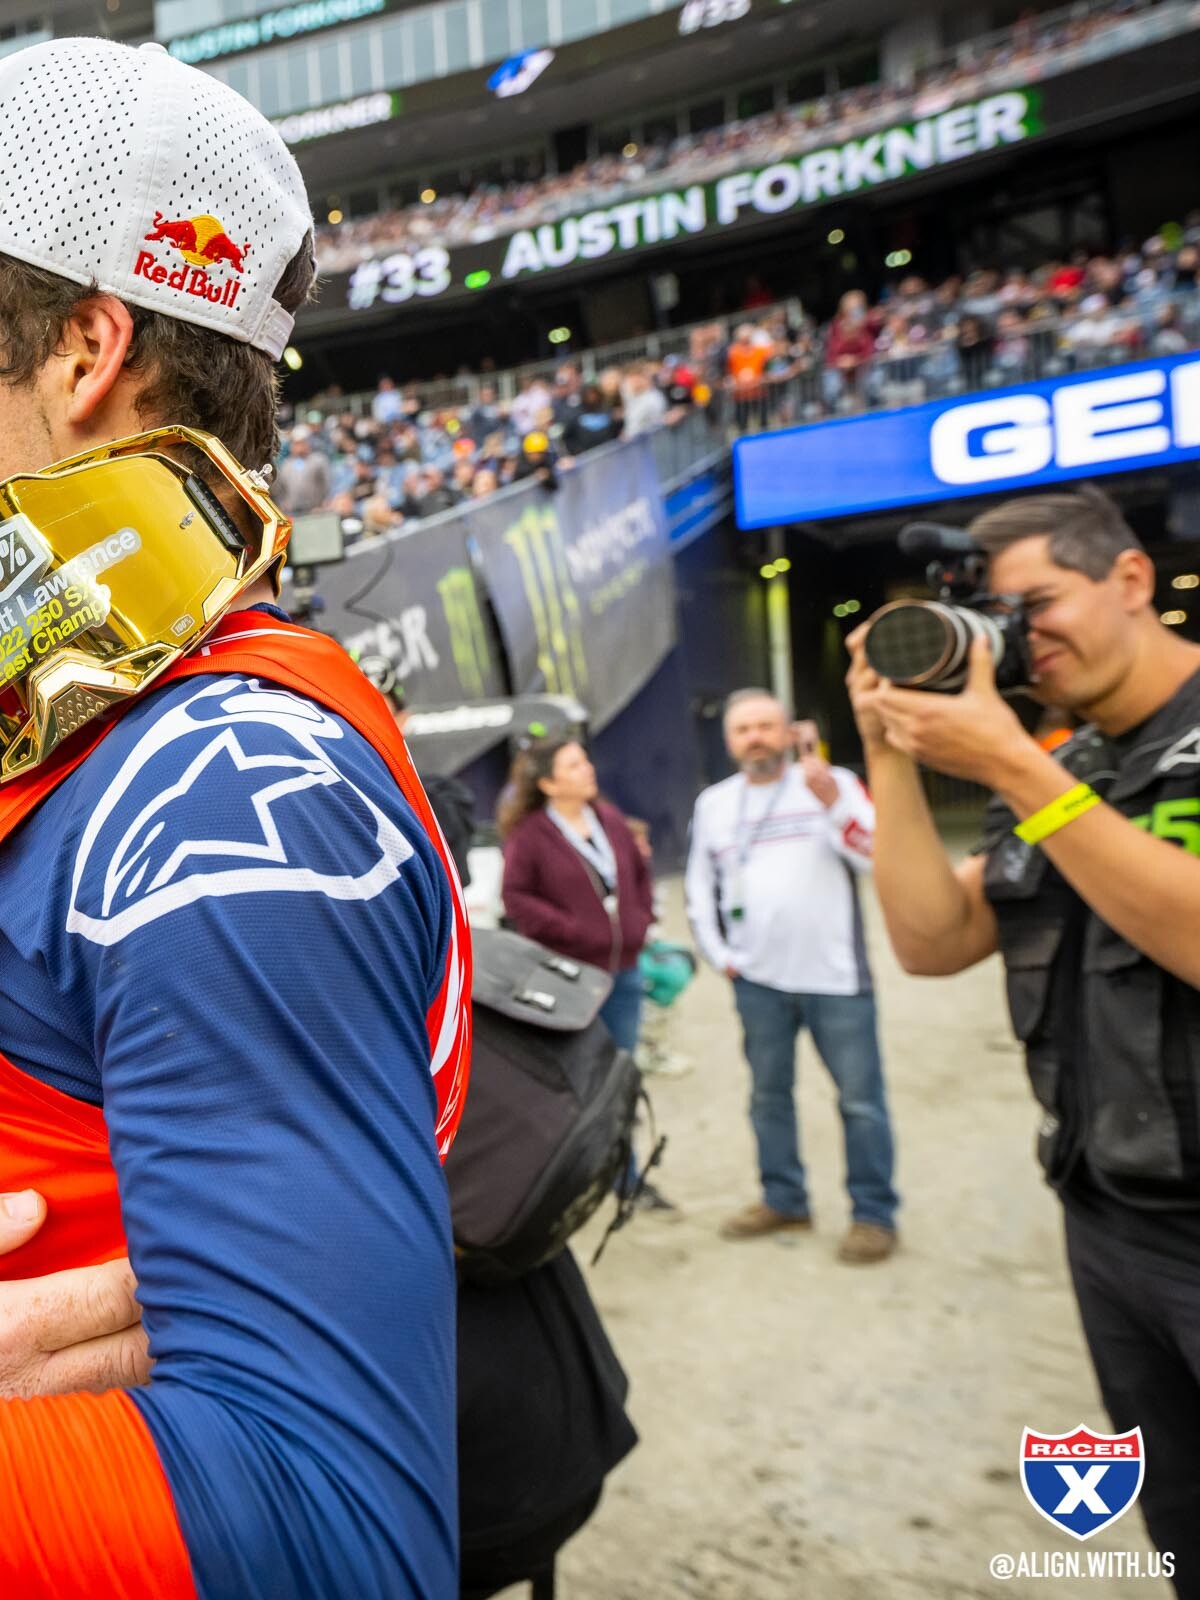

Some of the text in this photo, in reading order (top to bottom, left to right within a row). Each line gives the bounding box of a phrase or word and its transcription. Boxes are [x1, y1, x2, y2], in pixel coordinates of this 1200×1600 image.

[349, 92, 1028, 310] #33 AUSTIN FORKNER
[133, 250, 242, 308] Red Bull
[16, 531, 136, 616] Lawence
[26, 598, 63, 633] 250
[33, 599, 105, 654] Champ
